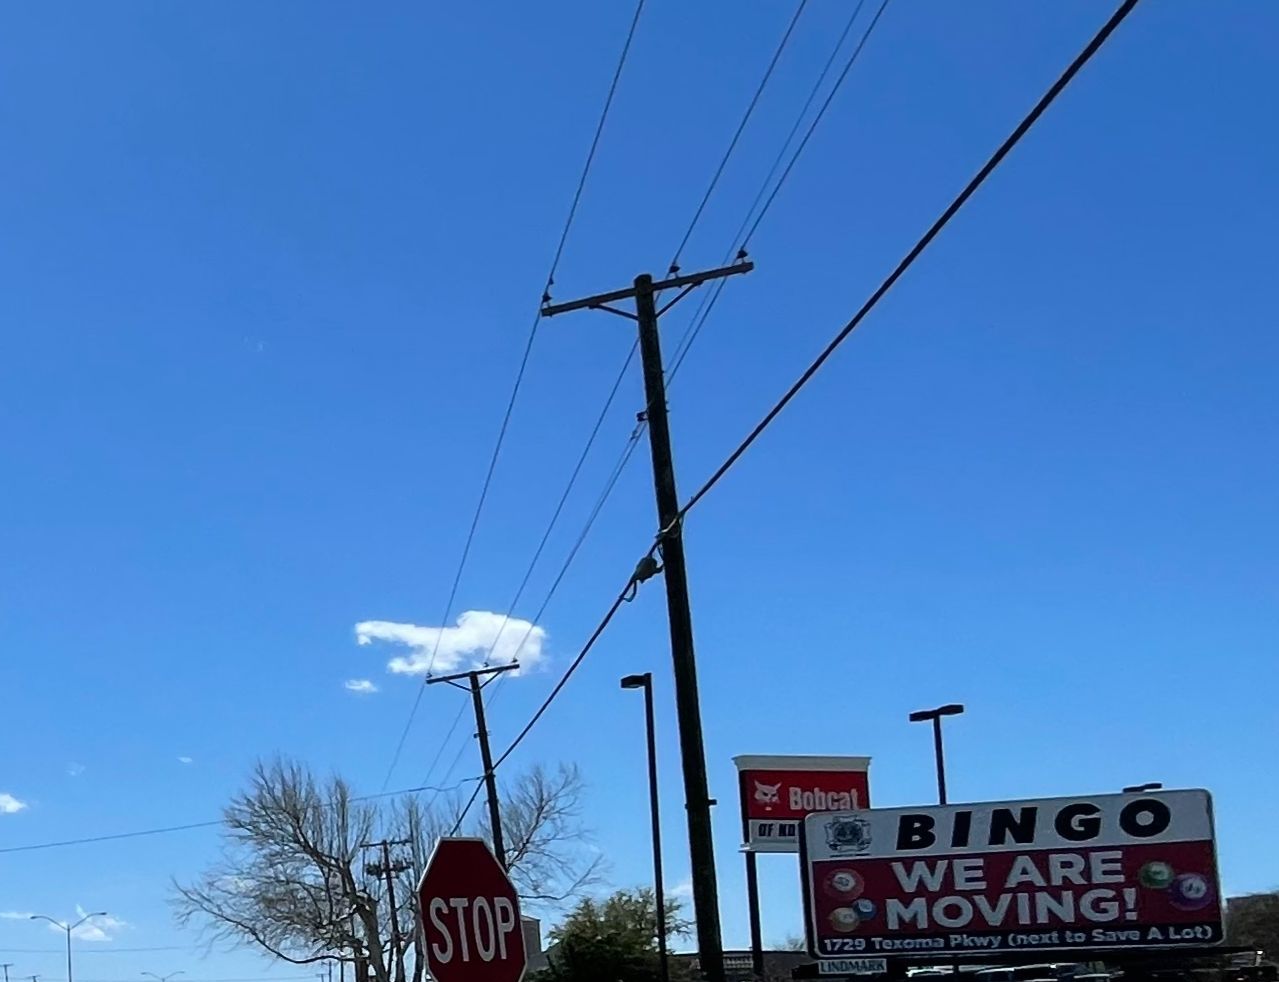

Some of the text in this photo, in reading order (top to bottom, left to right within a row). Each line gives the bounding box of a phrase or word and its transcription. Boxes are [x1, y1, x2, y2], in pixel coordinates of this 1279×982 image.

[788, 786, 860, 810] Bobcat
[896, 798, 1171, 850] BINGO
[890, 850, 1126, 893] WE ARE
[429, 896, 515, 964] STOP
[885, 888, 1138, 930] MOVING!
[824, 925, 1213, 951] 1729 Texoma Pkwy (next to Save A Lot)
